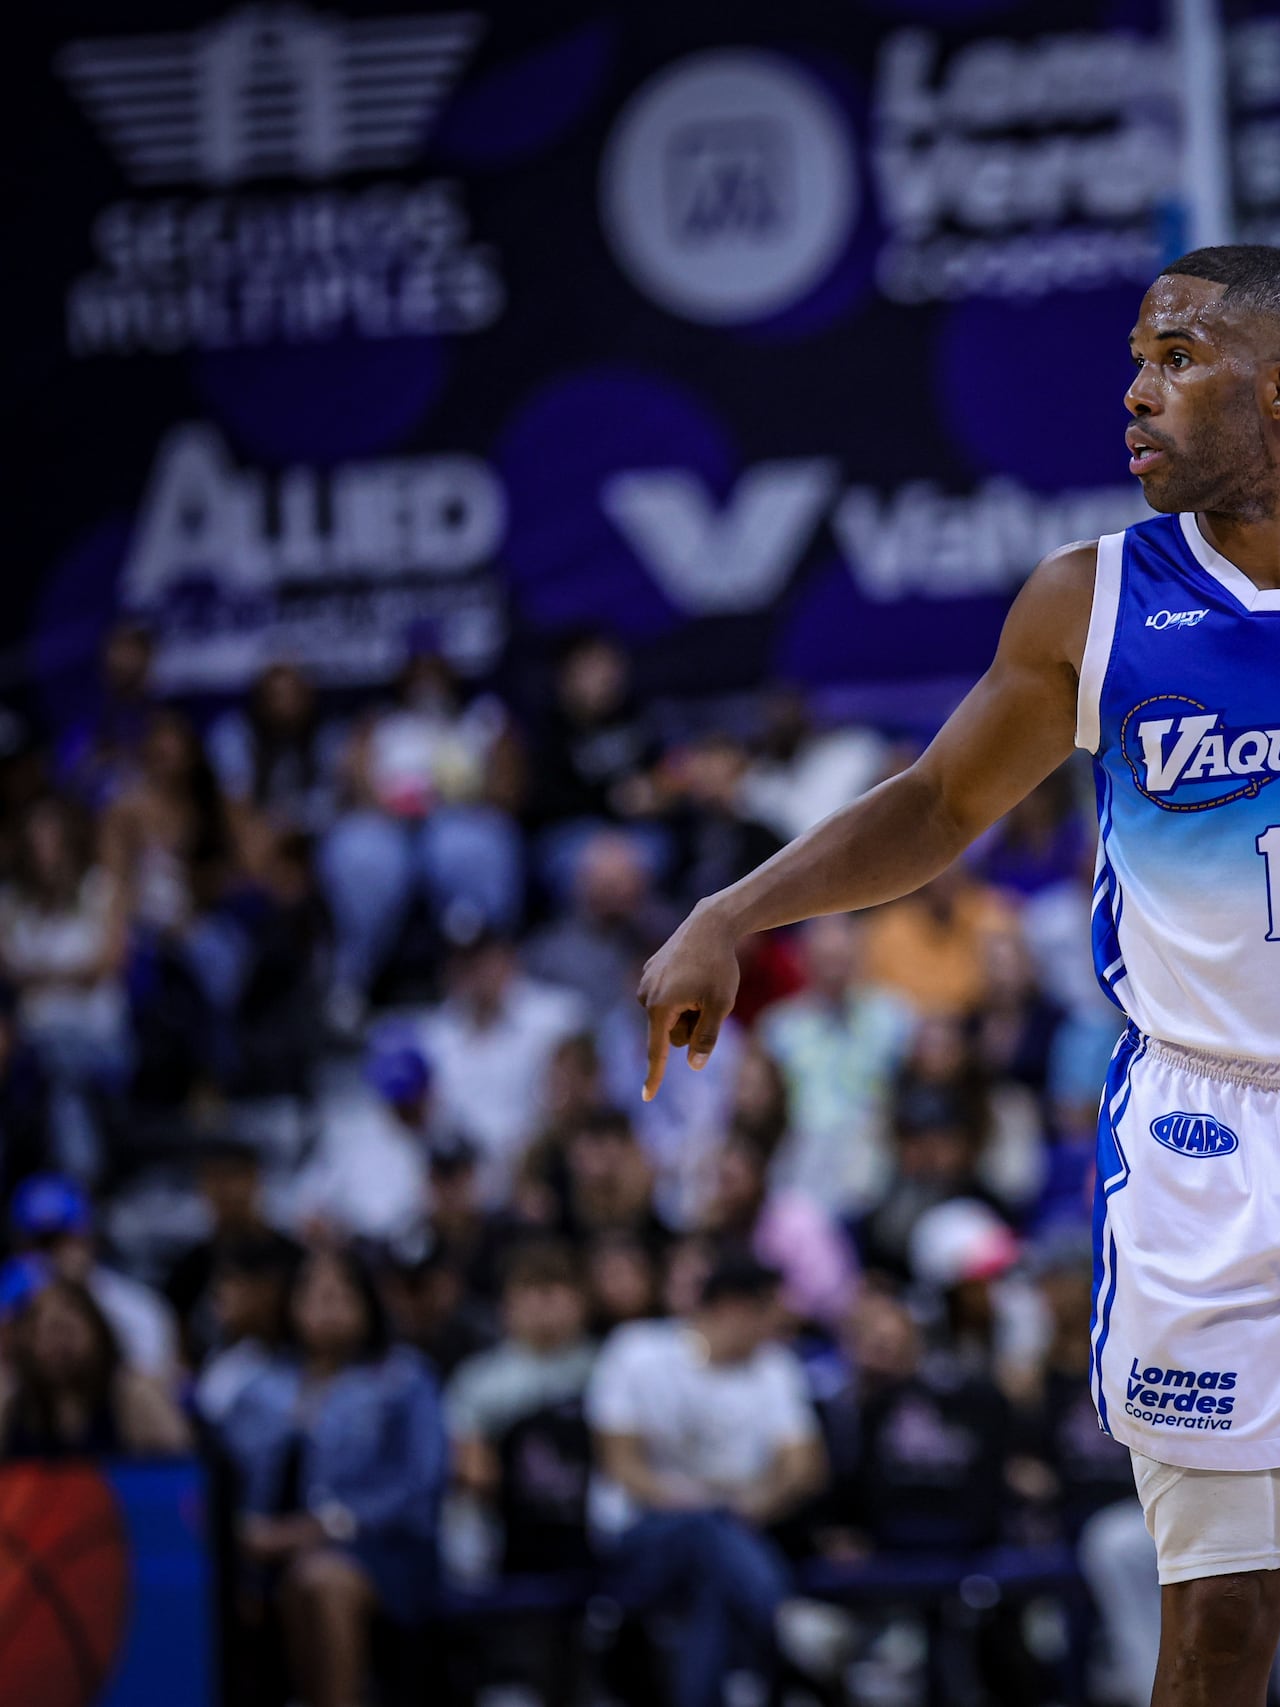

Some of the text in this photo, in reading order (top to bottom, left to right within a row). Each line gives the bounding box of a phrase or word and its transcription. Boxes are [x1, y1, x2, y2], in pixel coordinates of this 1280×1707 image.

[1130, 1357, 1238, 1390] Lomas
[1126, 1377, 1236, 1415] Verdes
[1125, 1402, 1233, 1430] Cooperativa
